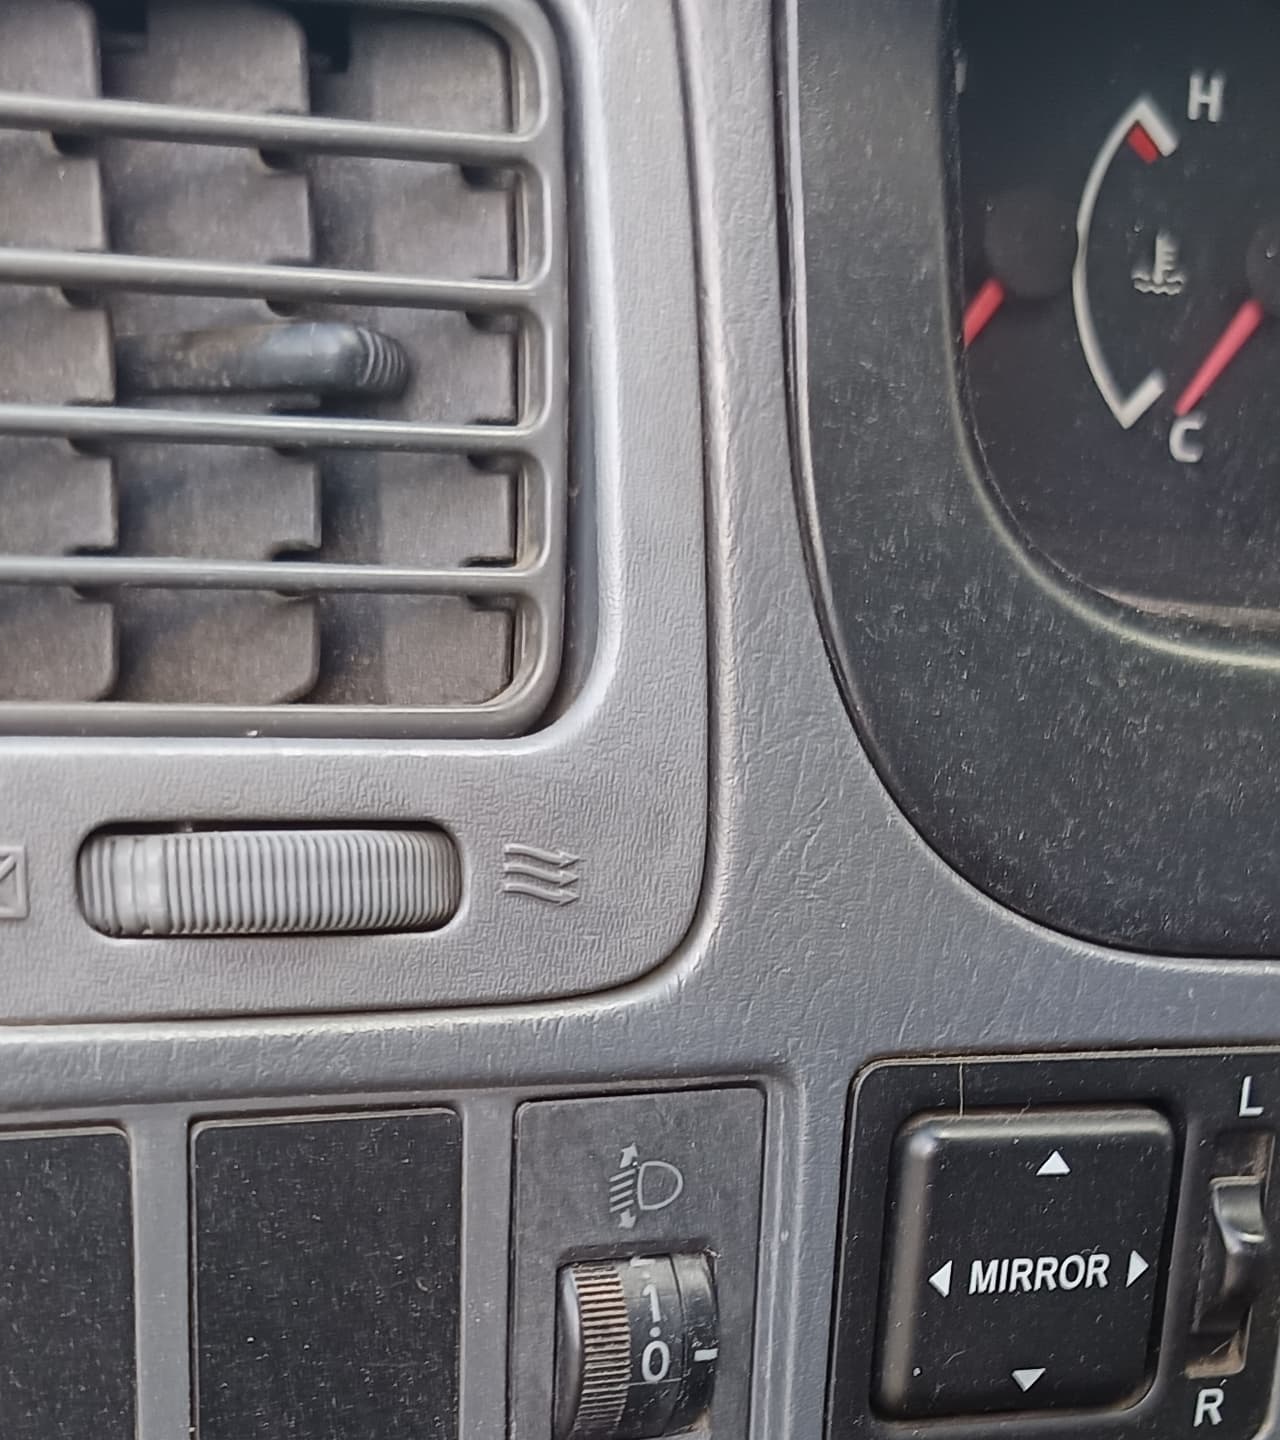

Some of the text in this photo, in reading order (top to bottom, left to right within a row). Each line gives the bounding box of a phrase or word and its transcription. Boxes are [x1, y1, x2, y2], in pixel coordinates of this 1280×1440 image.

[1187, 72, 1223, 123] H
[1167, 414, 1204, 464] C
[1238, 1075, 1264, 1118] L
[967, 1253, 1111, 1296] MIRROR
[642, 1283, 662, 1323] 1
[641, 1339, 671, 1382] 0
[1192, 1386, 1224, 1428] R
